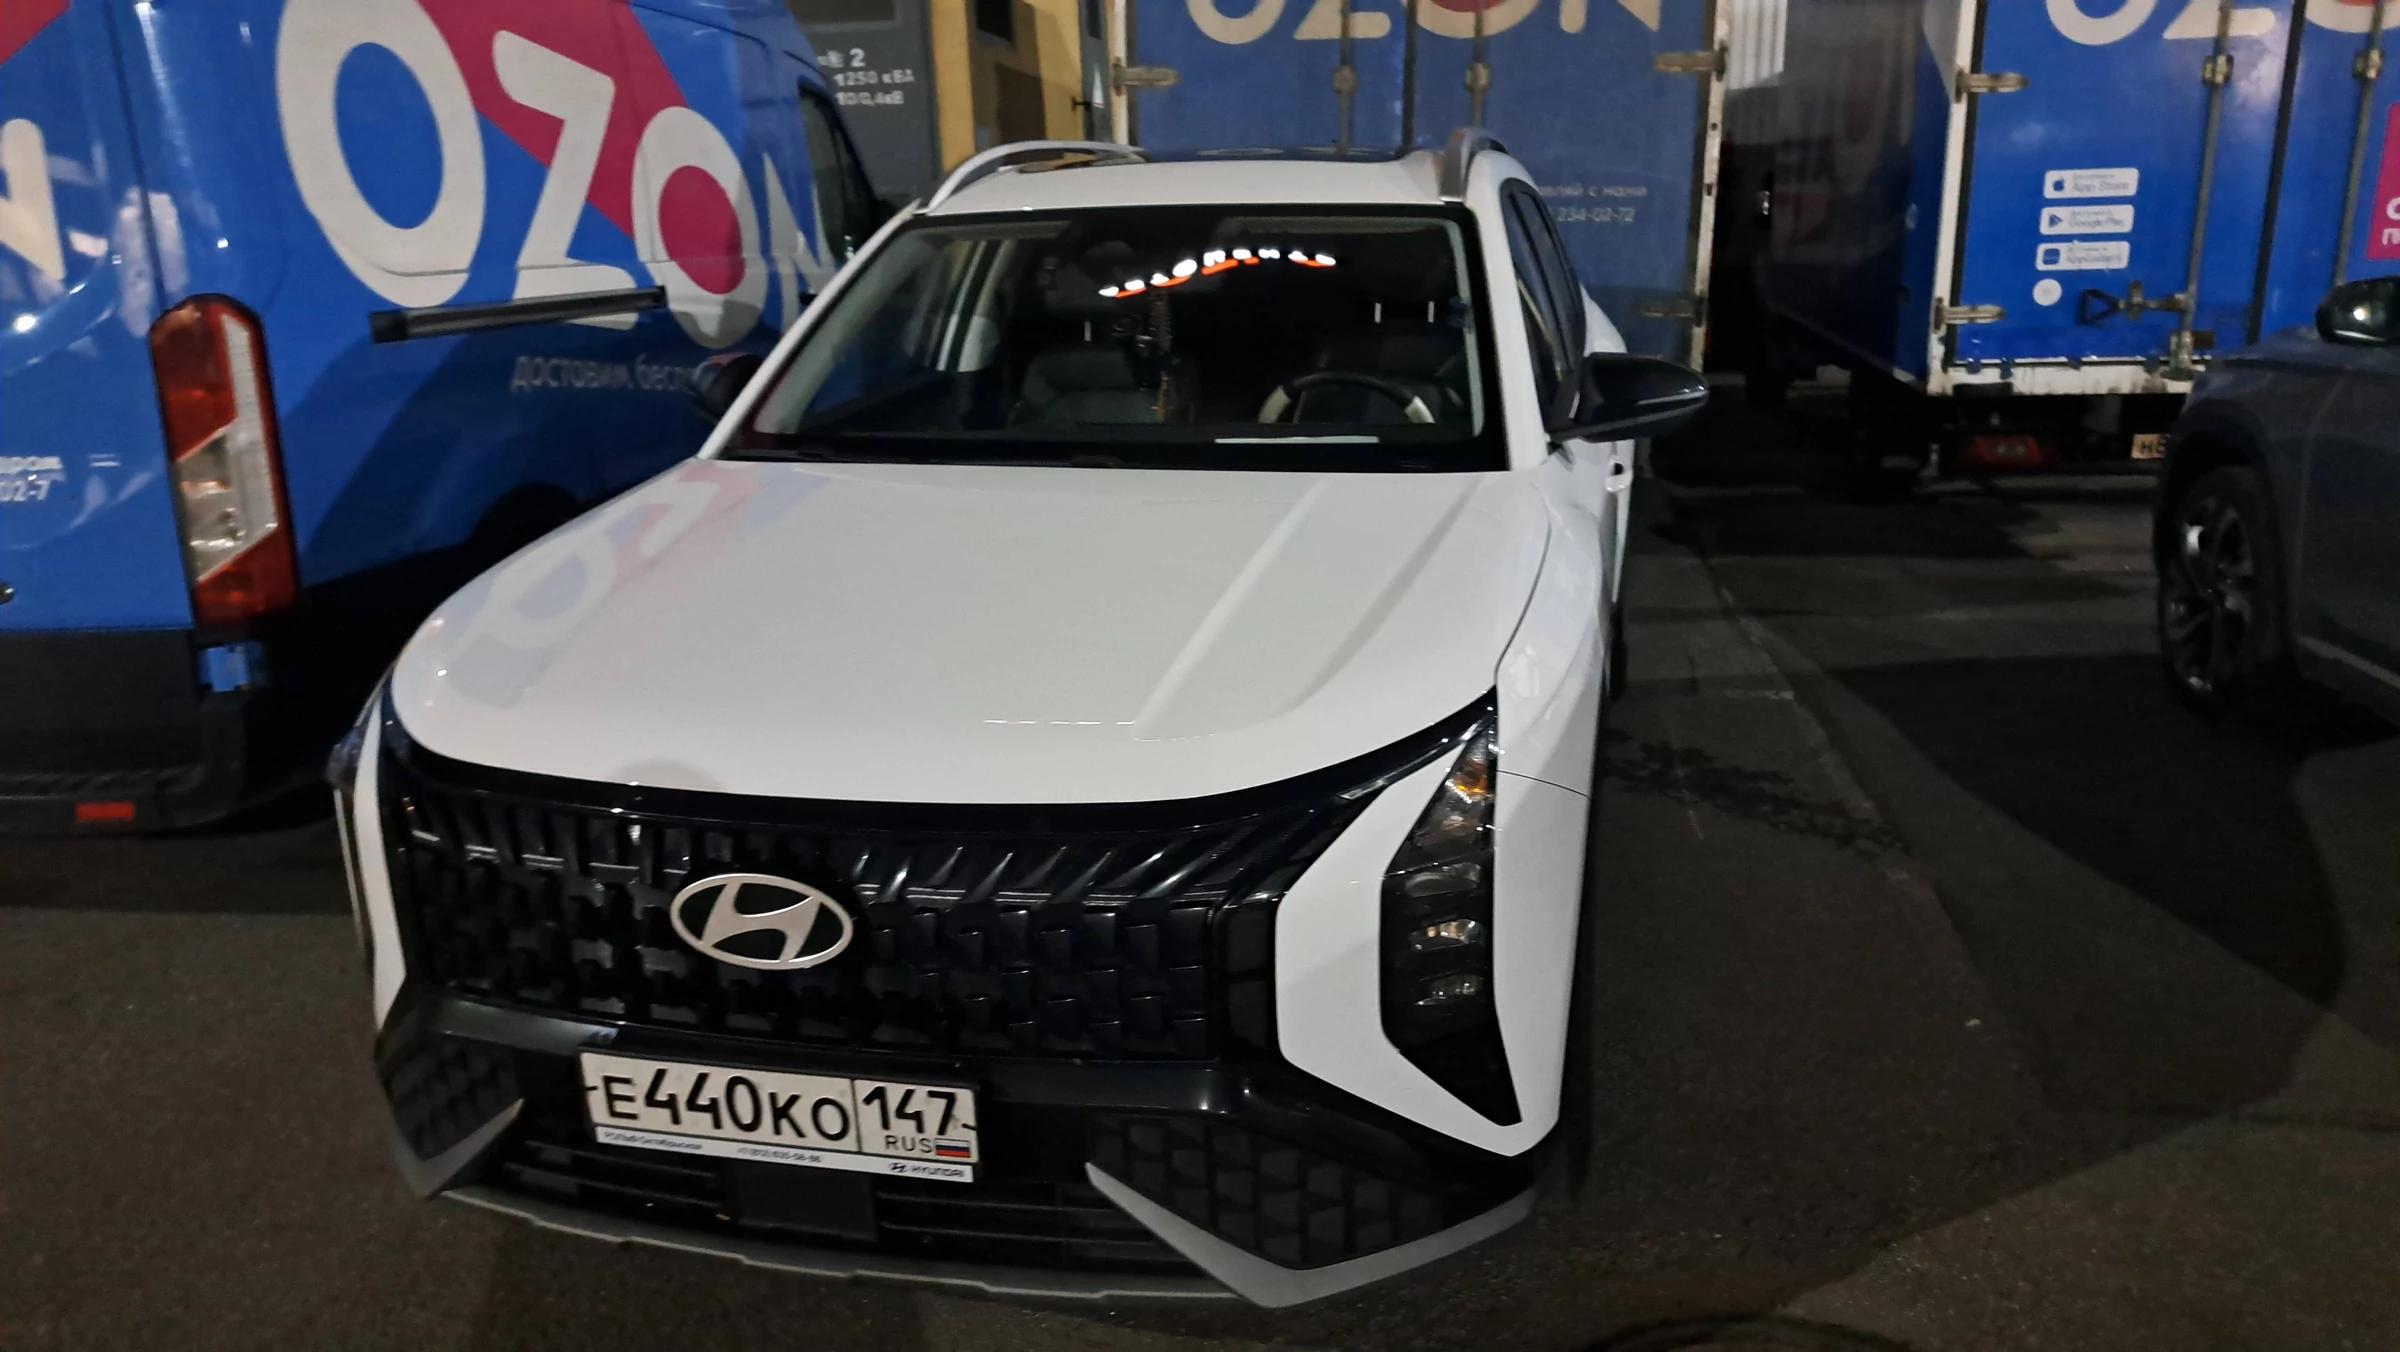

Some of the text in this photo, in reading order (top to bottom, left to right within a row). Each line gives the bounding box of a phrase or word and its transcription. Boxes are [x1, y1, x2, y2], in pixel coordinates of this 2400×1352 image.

[850, 48, 865, 67] 2
[863, 1085, 957, 1136] 147
[884, 1134, 933, 1154] RUS
